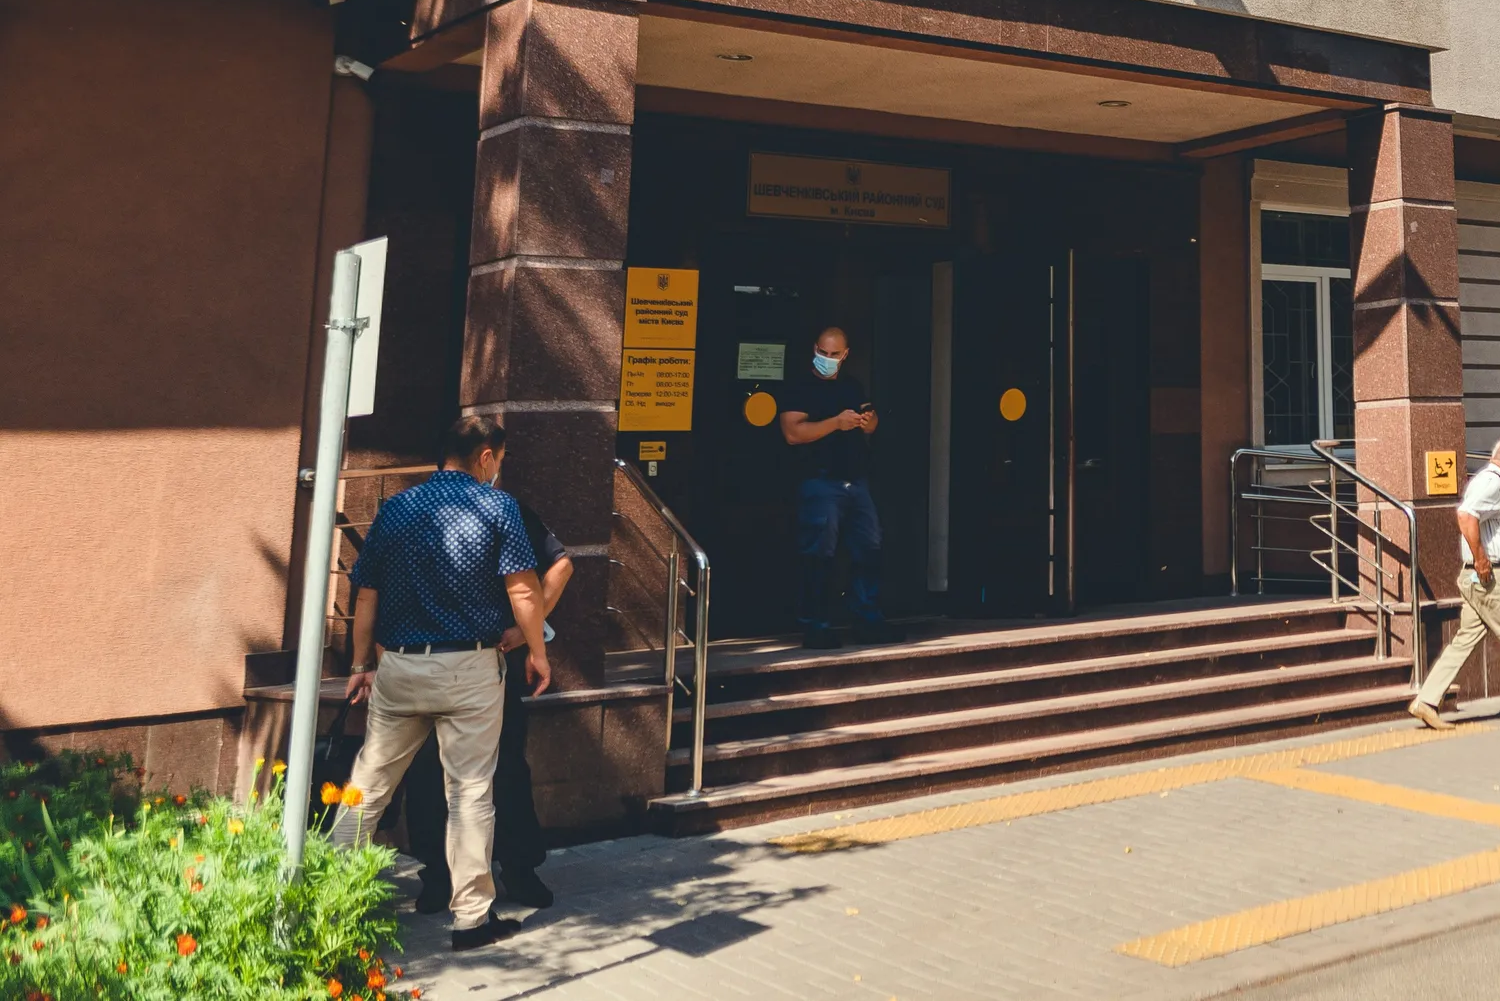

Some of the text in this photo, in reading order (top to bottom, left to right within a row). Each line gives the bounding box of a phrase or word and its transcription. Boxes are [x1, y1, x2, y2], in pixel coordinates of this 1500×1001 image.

[754, 183, 946, 210] ШЕВЧЕНКІВСЬКИЙ РАЙОННИЙ СУД
[628, 355, 656, 365] Графік
